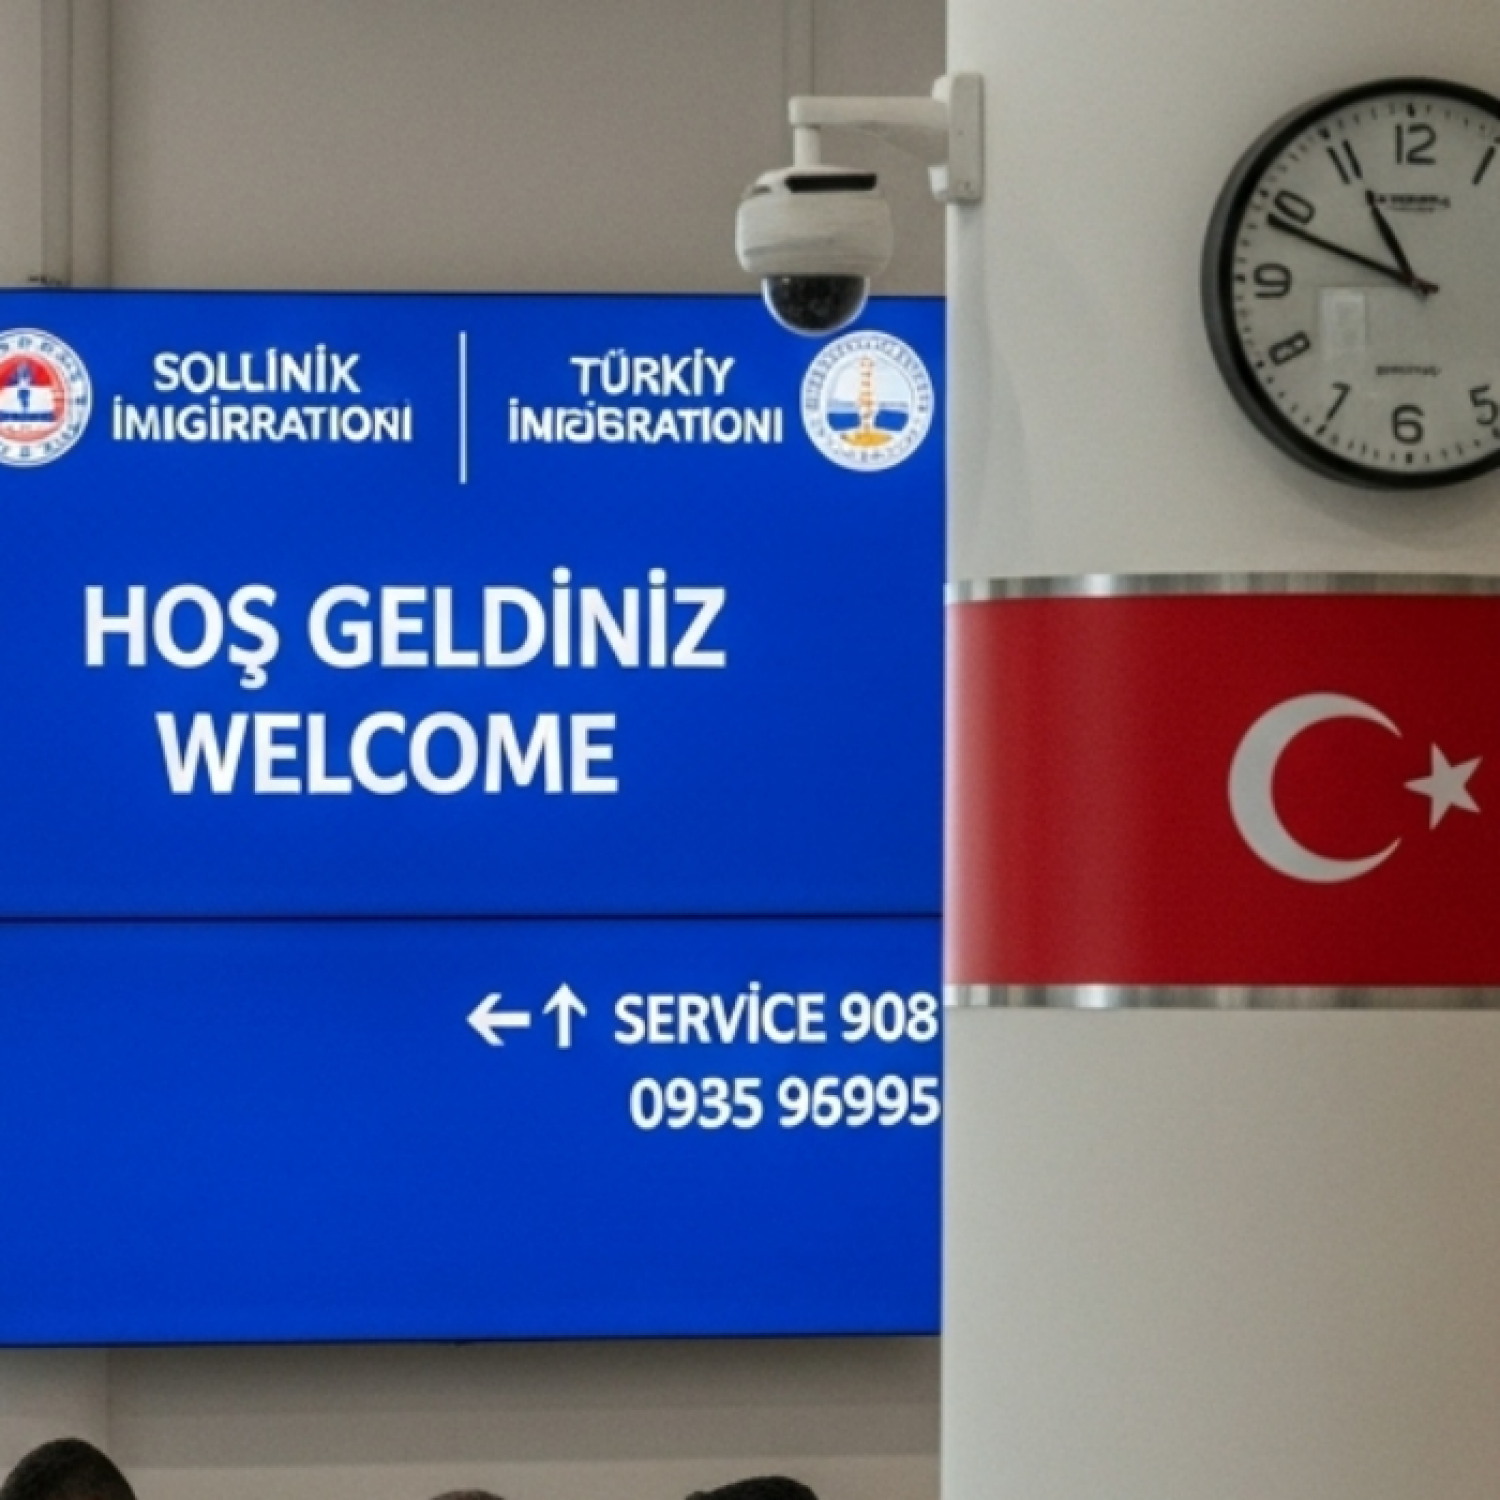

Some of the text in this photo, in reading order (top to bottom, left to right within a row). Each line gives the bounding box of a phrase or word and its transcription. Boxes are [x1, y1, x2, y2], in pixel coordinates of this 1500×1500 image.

[1394, 122, 1438, 166] 12
[1471, 145, 1496, 186] 1
[1252, 262, 1293, 299] 9
[1267, 331, 1312, 367] 8
[569, 348, 734, 396] TÜRKİY
[1325, 382, 1351, 423] 7
[1469, 384, 1500, 427] 5
[1390, 404, 1424, 445] 6
[85, 567, 725, 689] HOŞ GELDİNİZ
[155, 711, 618, 794] WELCOME
[614, 981, 939, 1044] SERVİCE 908
[629, 1075, 941, 1130] 0935 96995
